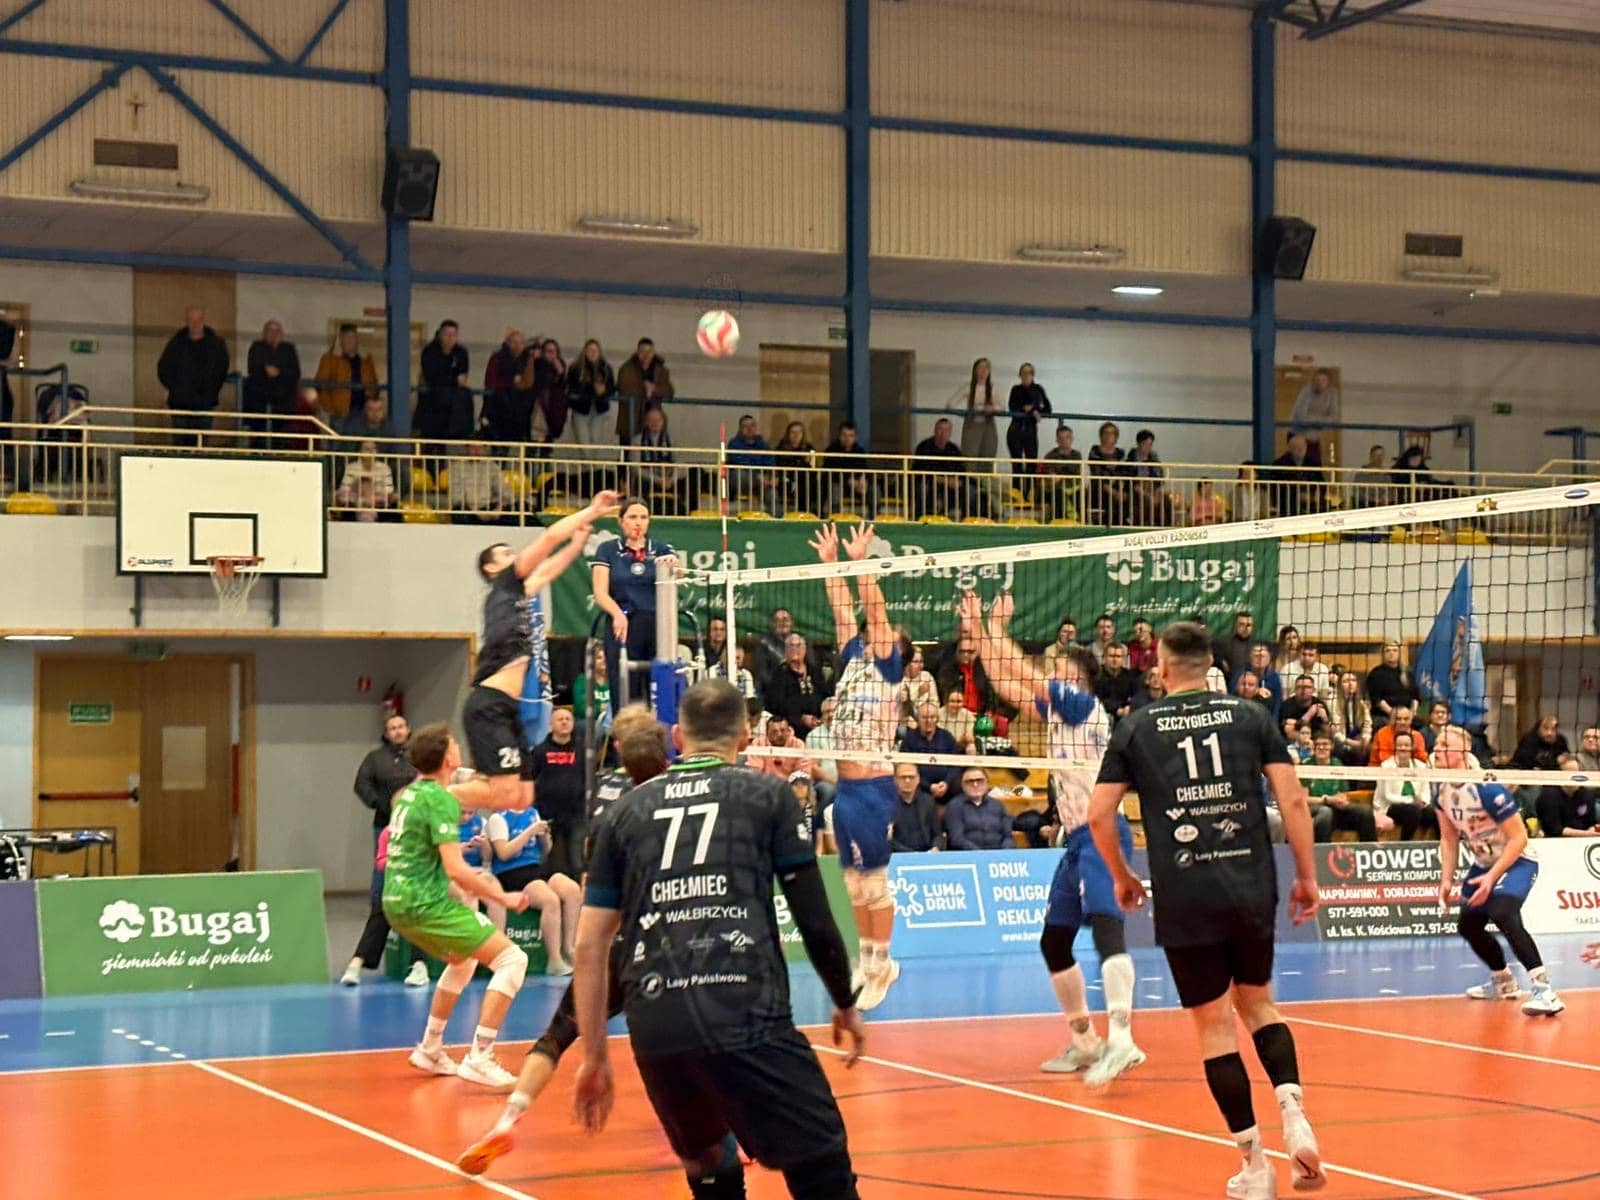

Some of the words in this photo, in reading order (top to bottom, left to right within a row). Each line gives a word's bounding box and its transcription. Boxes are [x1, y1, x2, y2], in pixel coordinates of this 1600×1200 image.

[1150, 550, 1255, 593] Bugaj
[1156, 709, 1234, 732] SZCZYGIELSKI
[1176, 731, 1224, 779] 11
[663, 778, 712, 800] KULIK
[1176, 781, 1233, 803] CHEŁMIEC
[653, 802, 720, 871] 77
[988, 861, 1030, 878] DRUK
[1355, 845, 1476, 878] powerN
[1365, 870, 1402, 882] SERWIS
[651, 874, 728, 905] CHEŁMIEC
[923, 883, 966, 898] LUMA
[666, 905, 748, 923] WAŁBRZYCH
[925, 896, 968, 912] DRUK
[1327, 905, 1390, 919] 577-591-000
[149, 902, 271, 945] Bugaj
[101, 950, 186, 976] ziemniaki
[187, 948, 211, 967] od
[208, 946, 273, 971] pokoleń
[666, 976, 690, 990] Lasy
